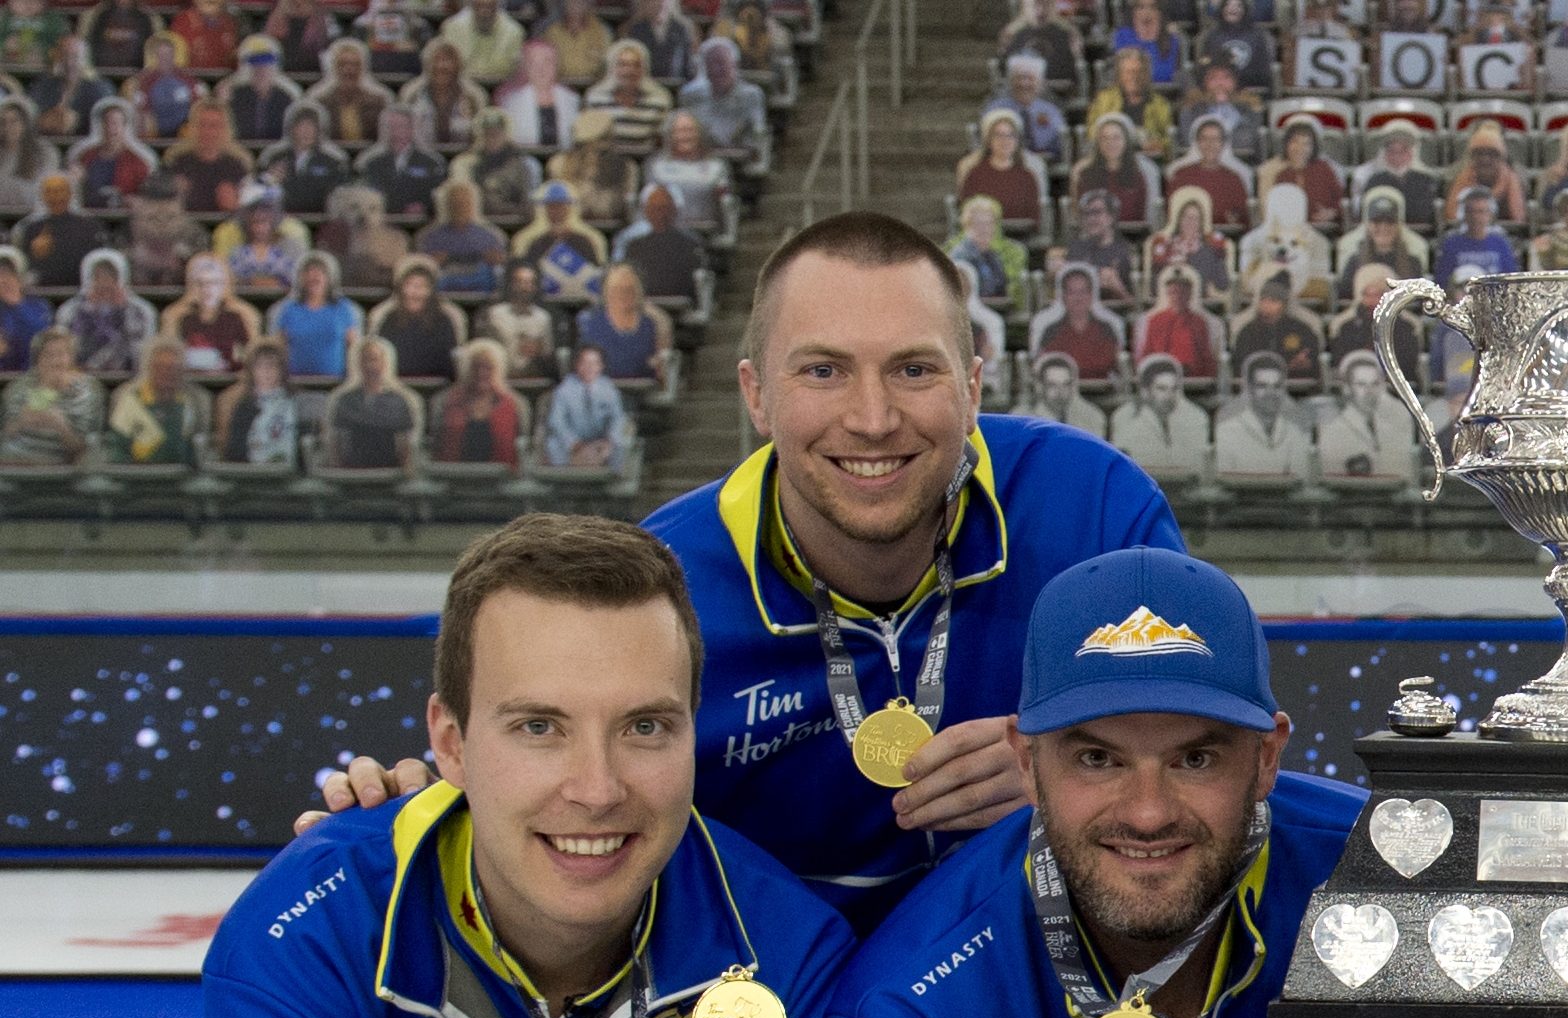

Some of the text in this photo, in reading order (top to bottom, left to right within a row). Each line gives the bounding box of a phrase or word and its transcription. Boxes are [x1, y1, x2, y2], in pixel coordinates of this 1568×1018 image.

[830, 661, 853, 677] 2021
[933, 650, 945, 687] CURLING
[733, 678, 804, 726] Tim
[917, 704, 941, 717] 2021
[722, 720, 842, 768] Horton
[863, 744, 915, 768] BRIE
[1034, 862, 1051, 899] CANADA
[1046, 857, 1064, 898] CURLING
[267, 866, 347, 939] DYNASTY
[1042, 914, 1071, 925] 2021
[911, 925, 995, 997] DYNASTY
[1060, 972, 1088, 983] 2021
